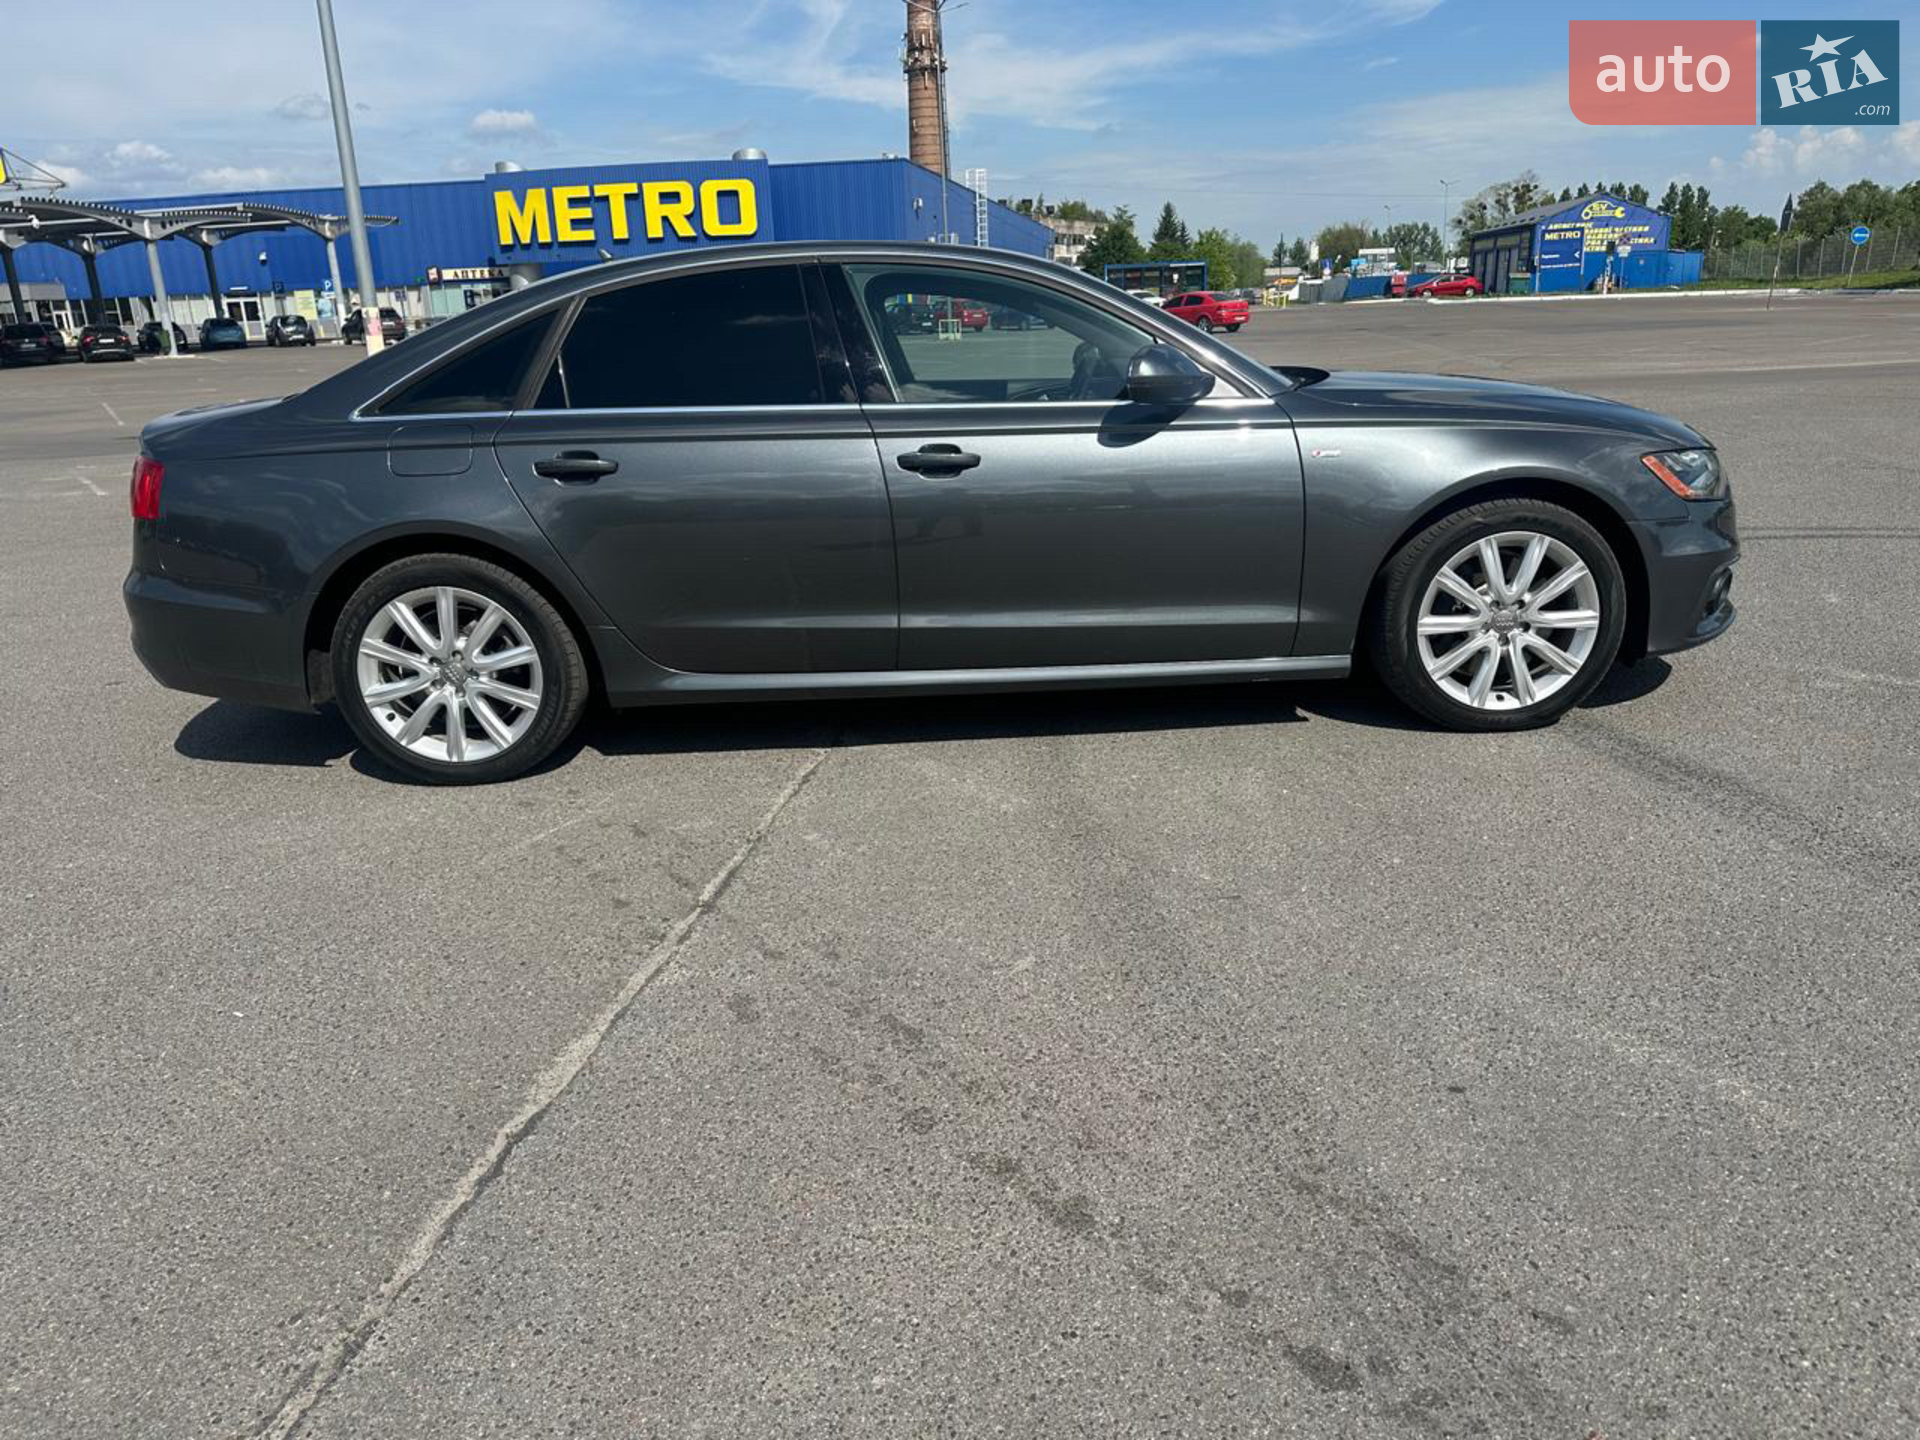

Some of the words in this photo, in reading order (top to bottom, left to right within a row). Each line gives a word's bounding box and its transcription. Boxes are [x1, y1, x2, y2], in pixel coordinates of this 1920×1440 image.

[493, 178, 758, 246] METRO
[1544, 230, 1581, 241] METRO
[453, 269, 504, 279] АПТЕКА
